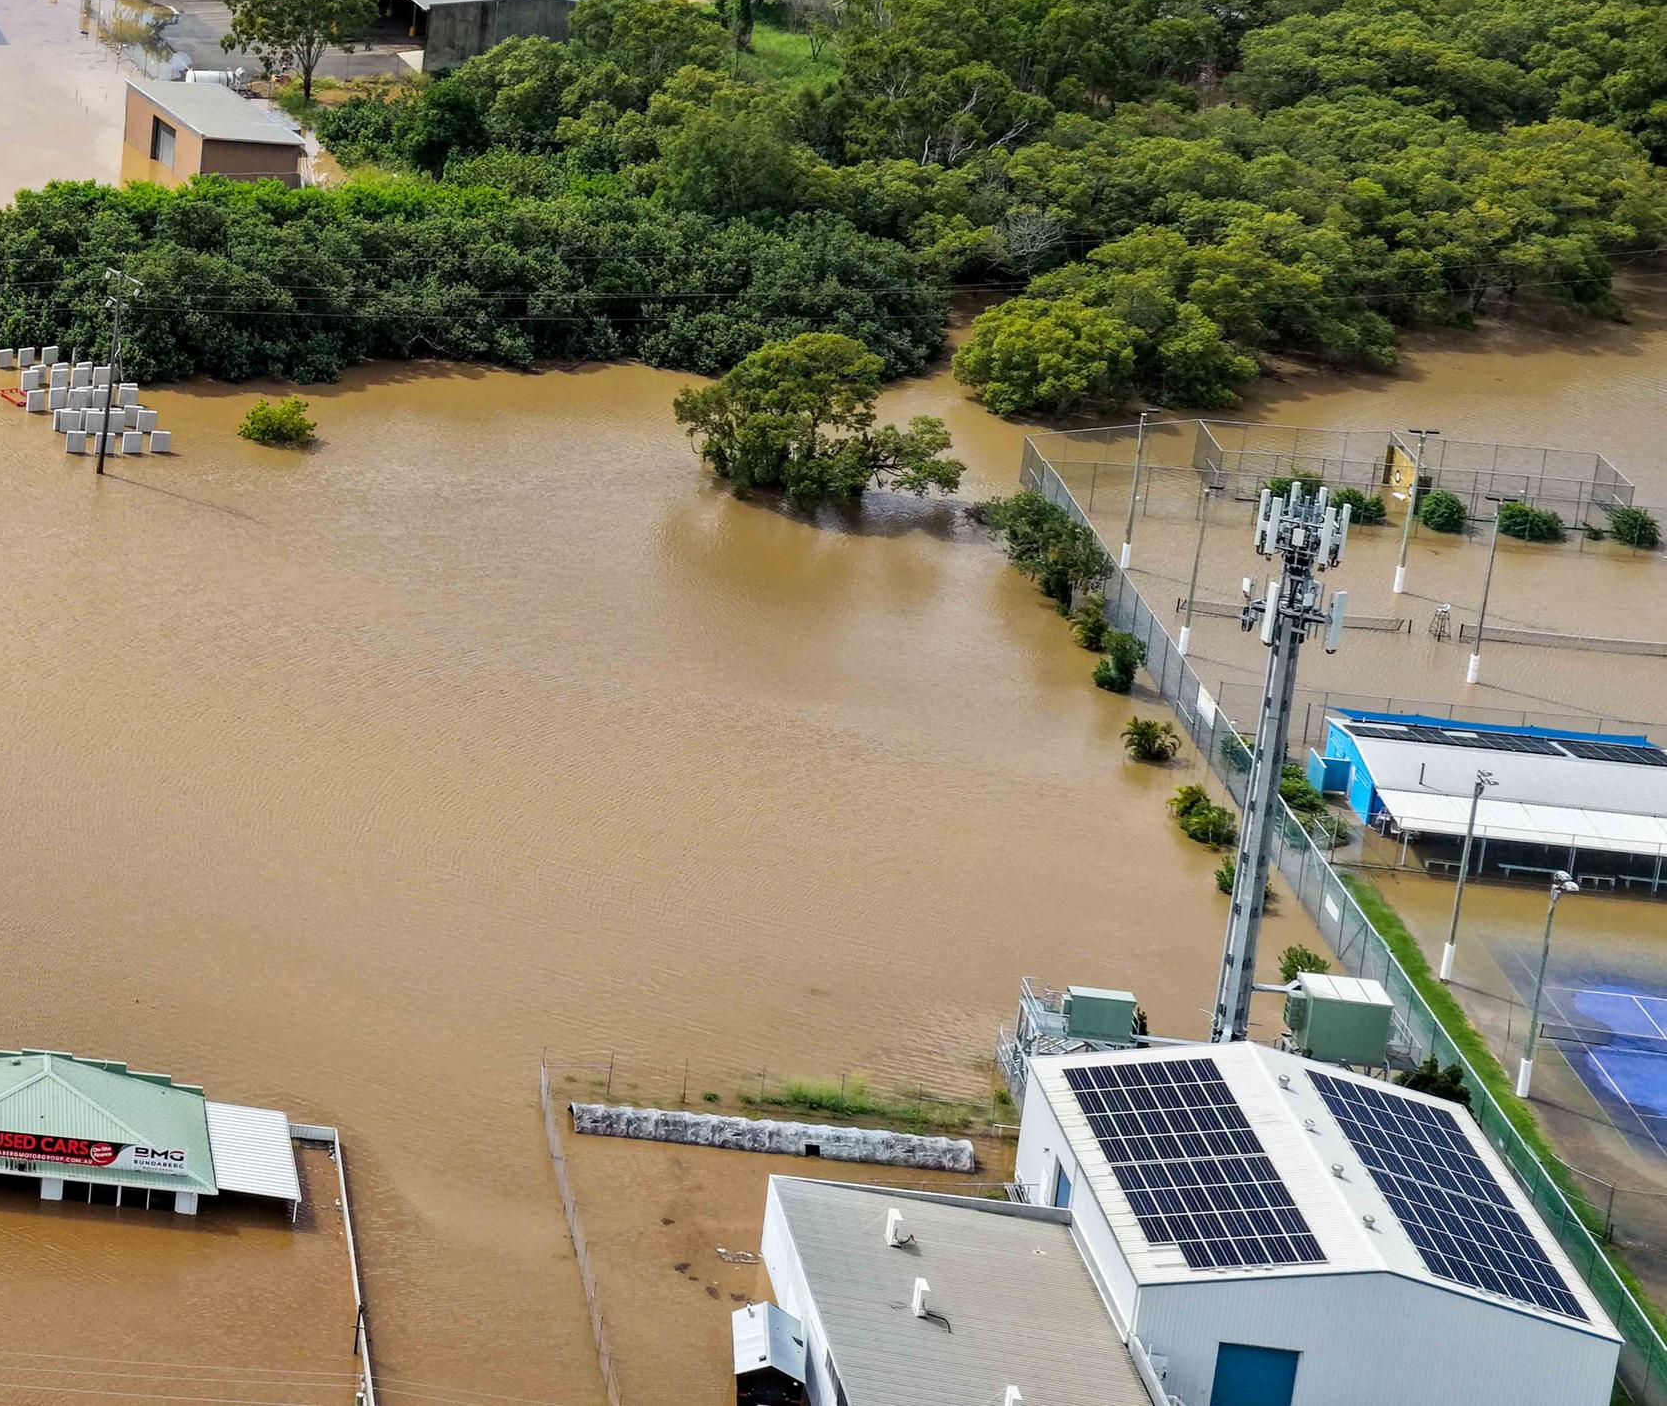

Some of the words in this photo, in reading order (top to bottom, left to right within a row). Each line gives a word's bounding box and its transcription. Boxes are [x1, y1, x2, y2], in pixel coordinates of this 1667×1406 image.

[41, 1137, 90, 1156] CARS
[134, 1146, 185, 1162] BMG
[133, 1159, 184, 1169] BUNDABERG
